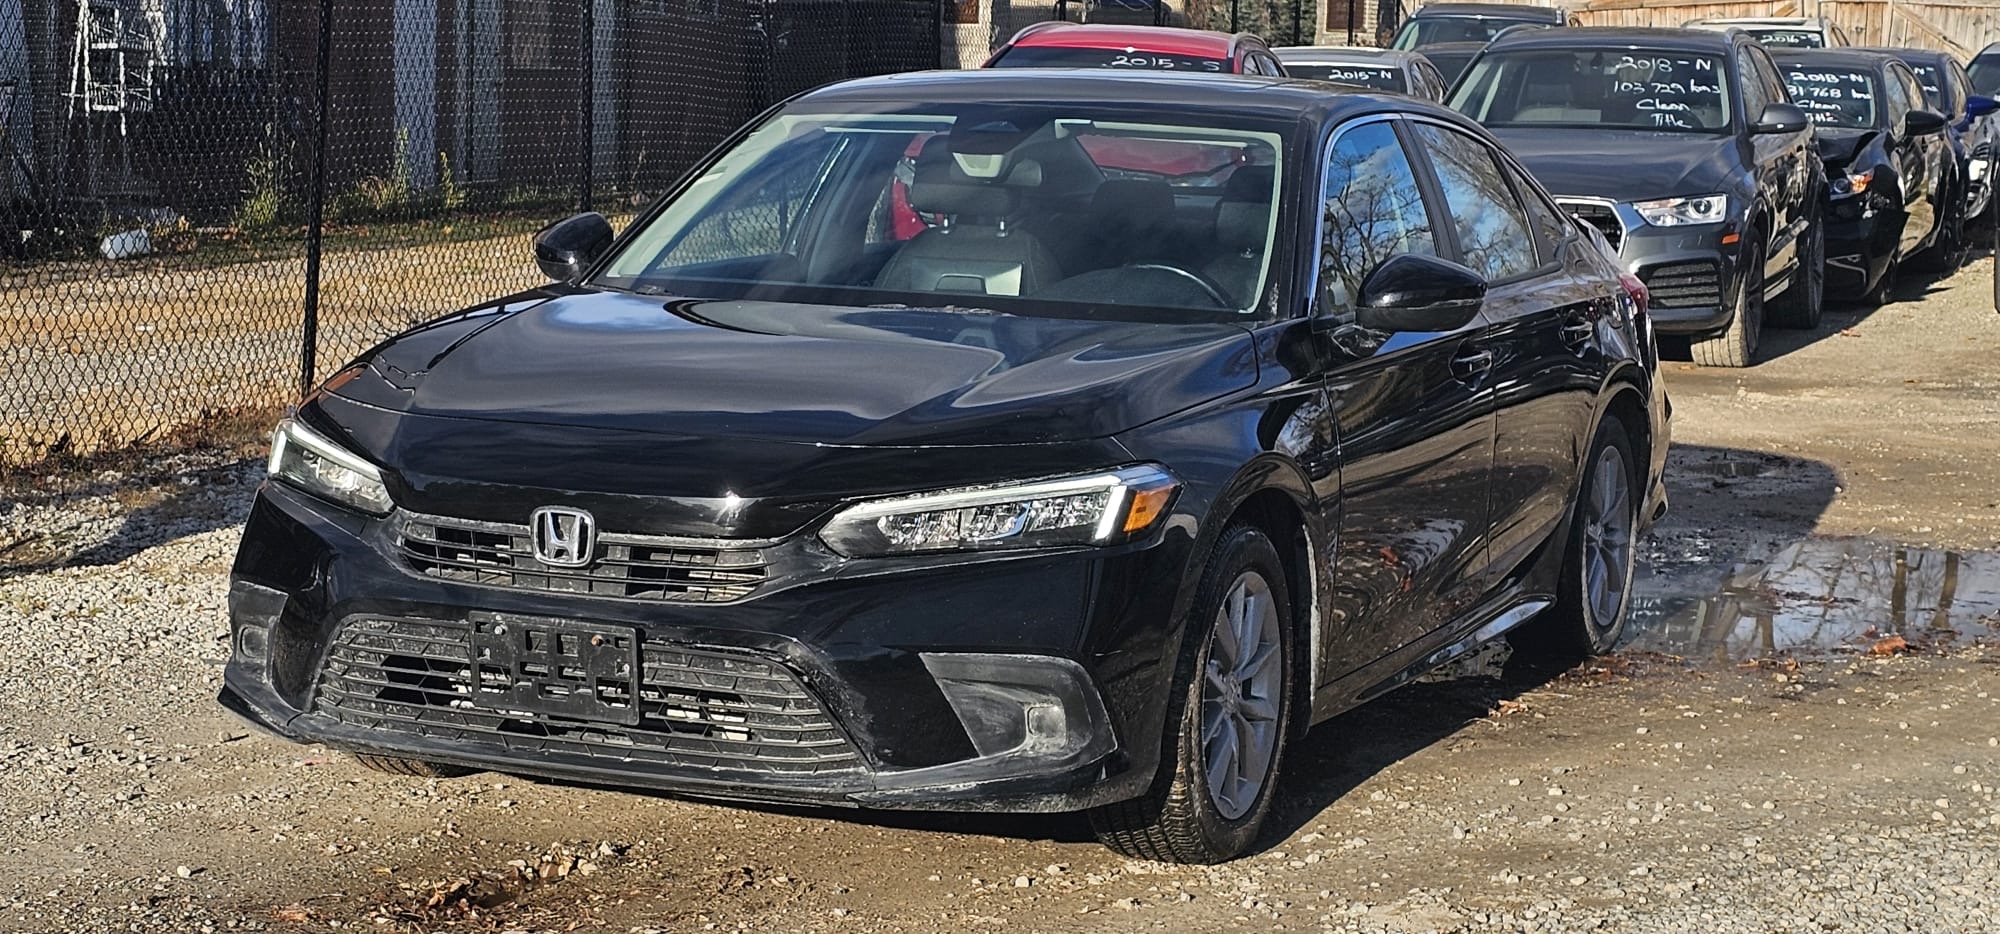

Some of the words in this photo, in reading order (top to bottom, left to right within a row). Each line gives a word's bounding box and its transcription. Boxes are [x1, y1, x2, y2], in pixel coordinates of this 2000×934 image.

[1111, 55, 1175, 69] 2015
[1613, 80, 1646, 95] 103
[1650, 82, 1686, 95] 729
[1635, 98, 1691, 112] Clean
[1650, 112, 1693, 129] Title
